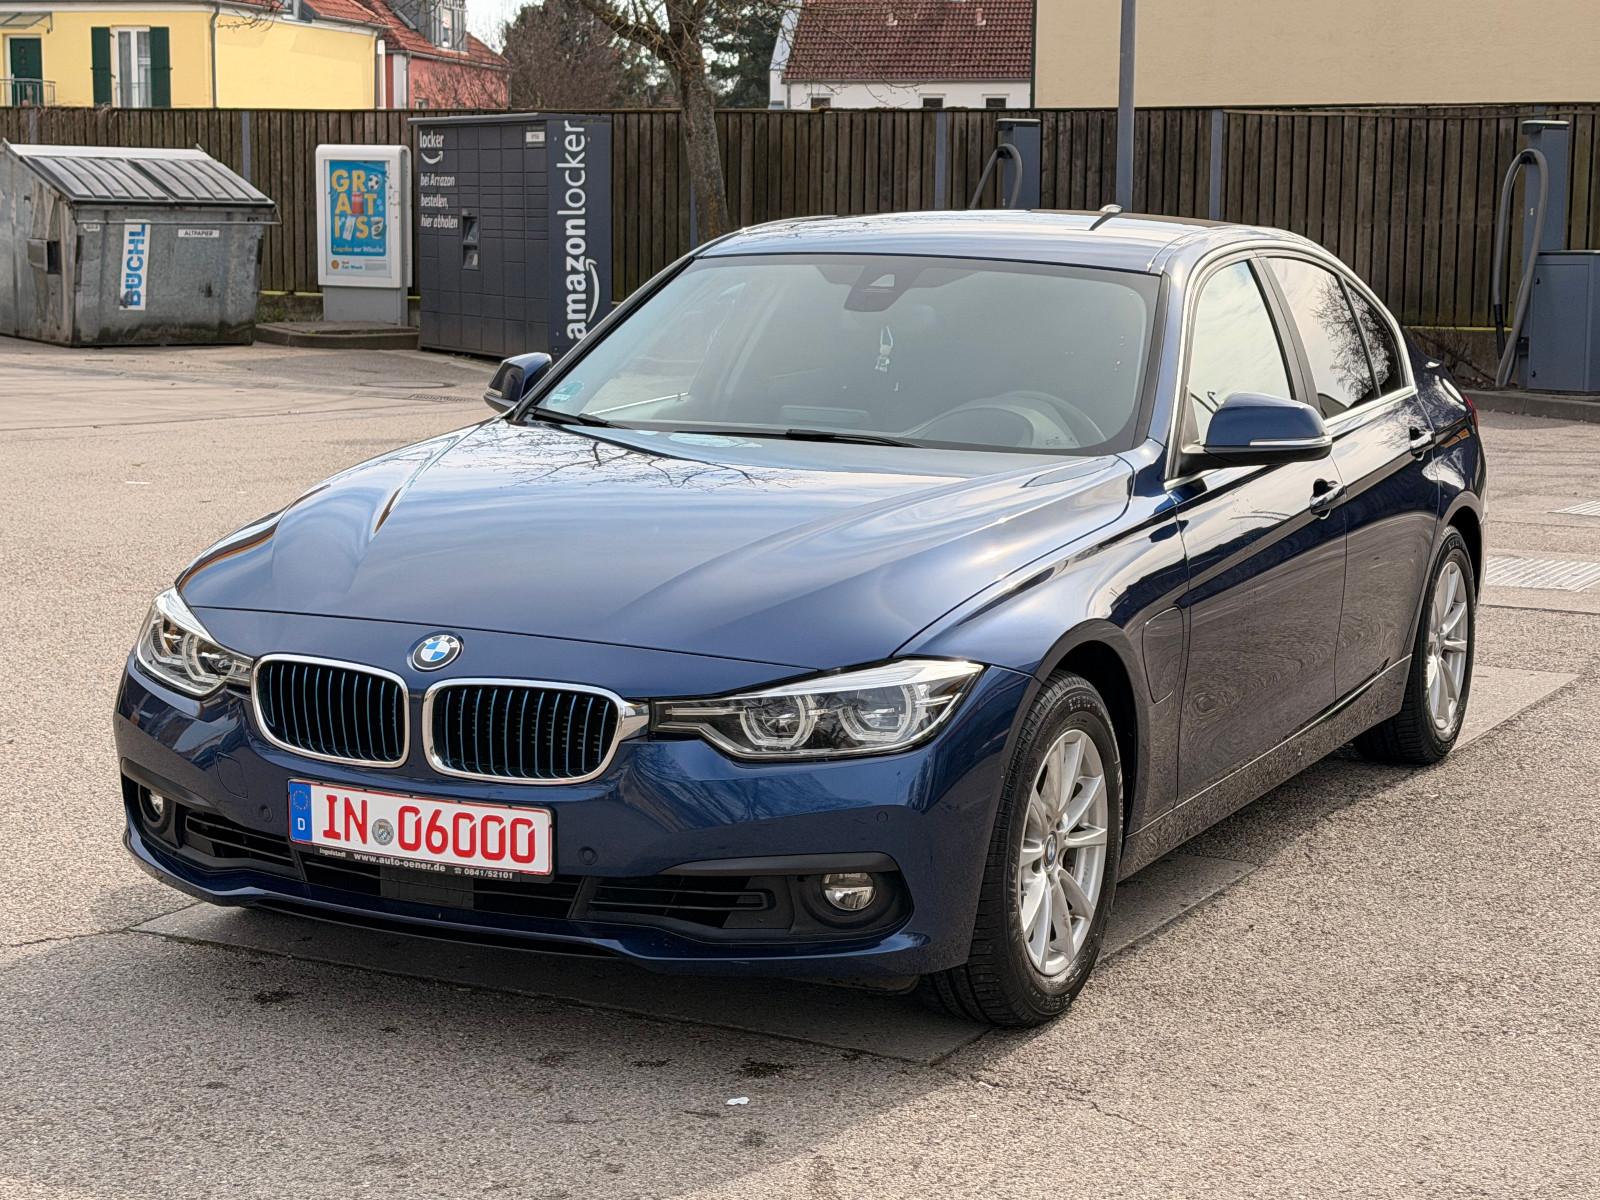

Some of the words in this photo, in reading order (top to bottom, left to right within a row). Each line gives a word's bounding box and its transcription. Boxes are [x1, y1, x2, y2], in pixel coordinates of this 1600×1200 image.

[419, 130, 444, 149] locker
[420, 173, 429, 186] bei
[421, 215, 433, 227] hier
[433, 215, 458, 229] abholen
[297, 817, 306, 831] D
[322, 794, 368, 845] IN
[397, 805, 536, 864] 06000
[319, 847, 346, 858] Ingolstadt
[354, 853, 446, 872] www.auto-oener.de
[464, 867, 513, 880] 0841/52101
